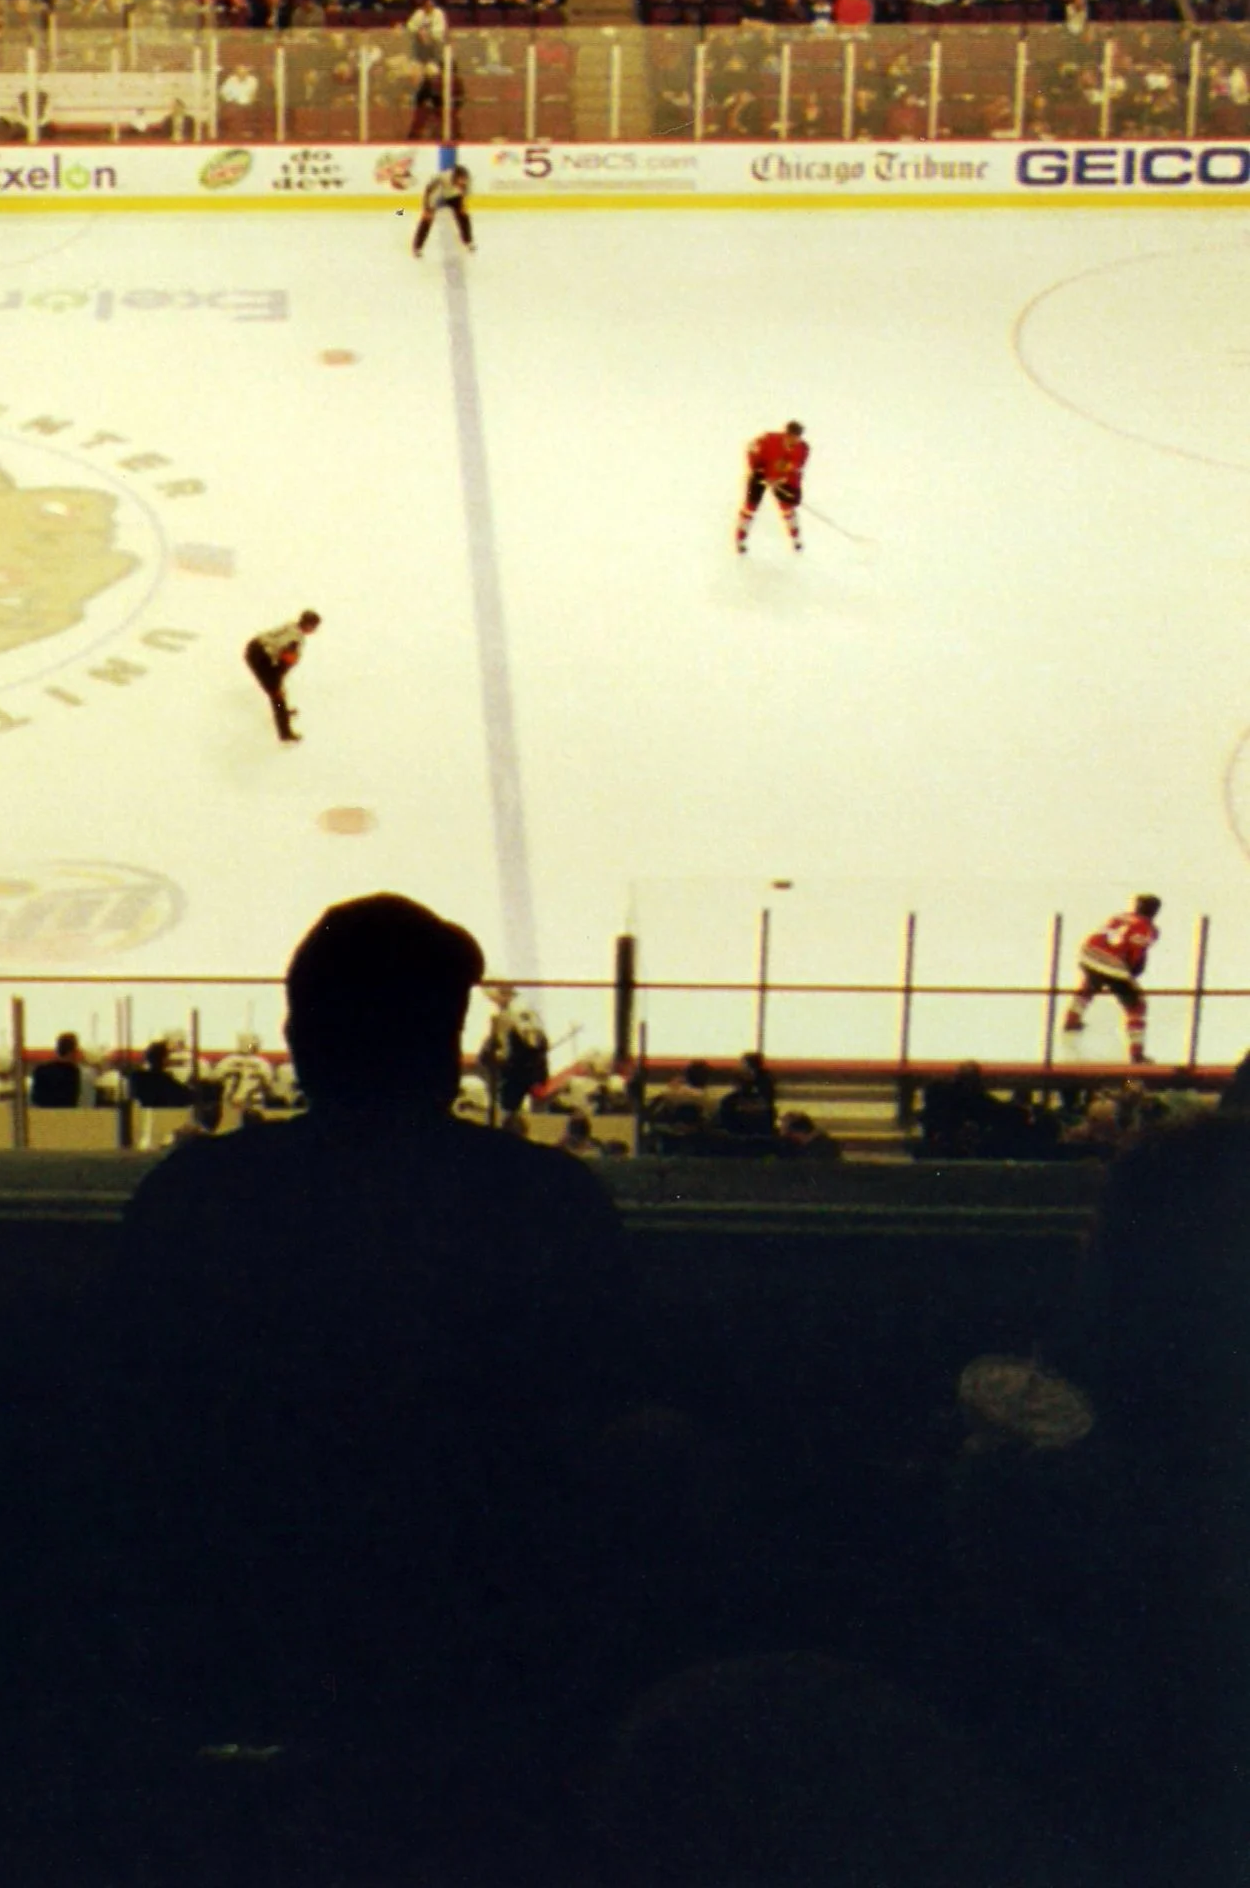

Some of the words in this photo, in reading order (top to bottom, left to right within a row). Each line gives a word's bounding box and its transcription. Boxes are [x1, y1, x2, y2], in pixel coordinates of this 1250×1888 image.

[523, 148, 553, 178] 5
[752, 152, 865, 183] Chicago
[874, 150, 989, 181] Tribune
[1016, 148, 1250, 186] GEICO
